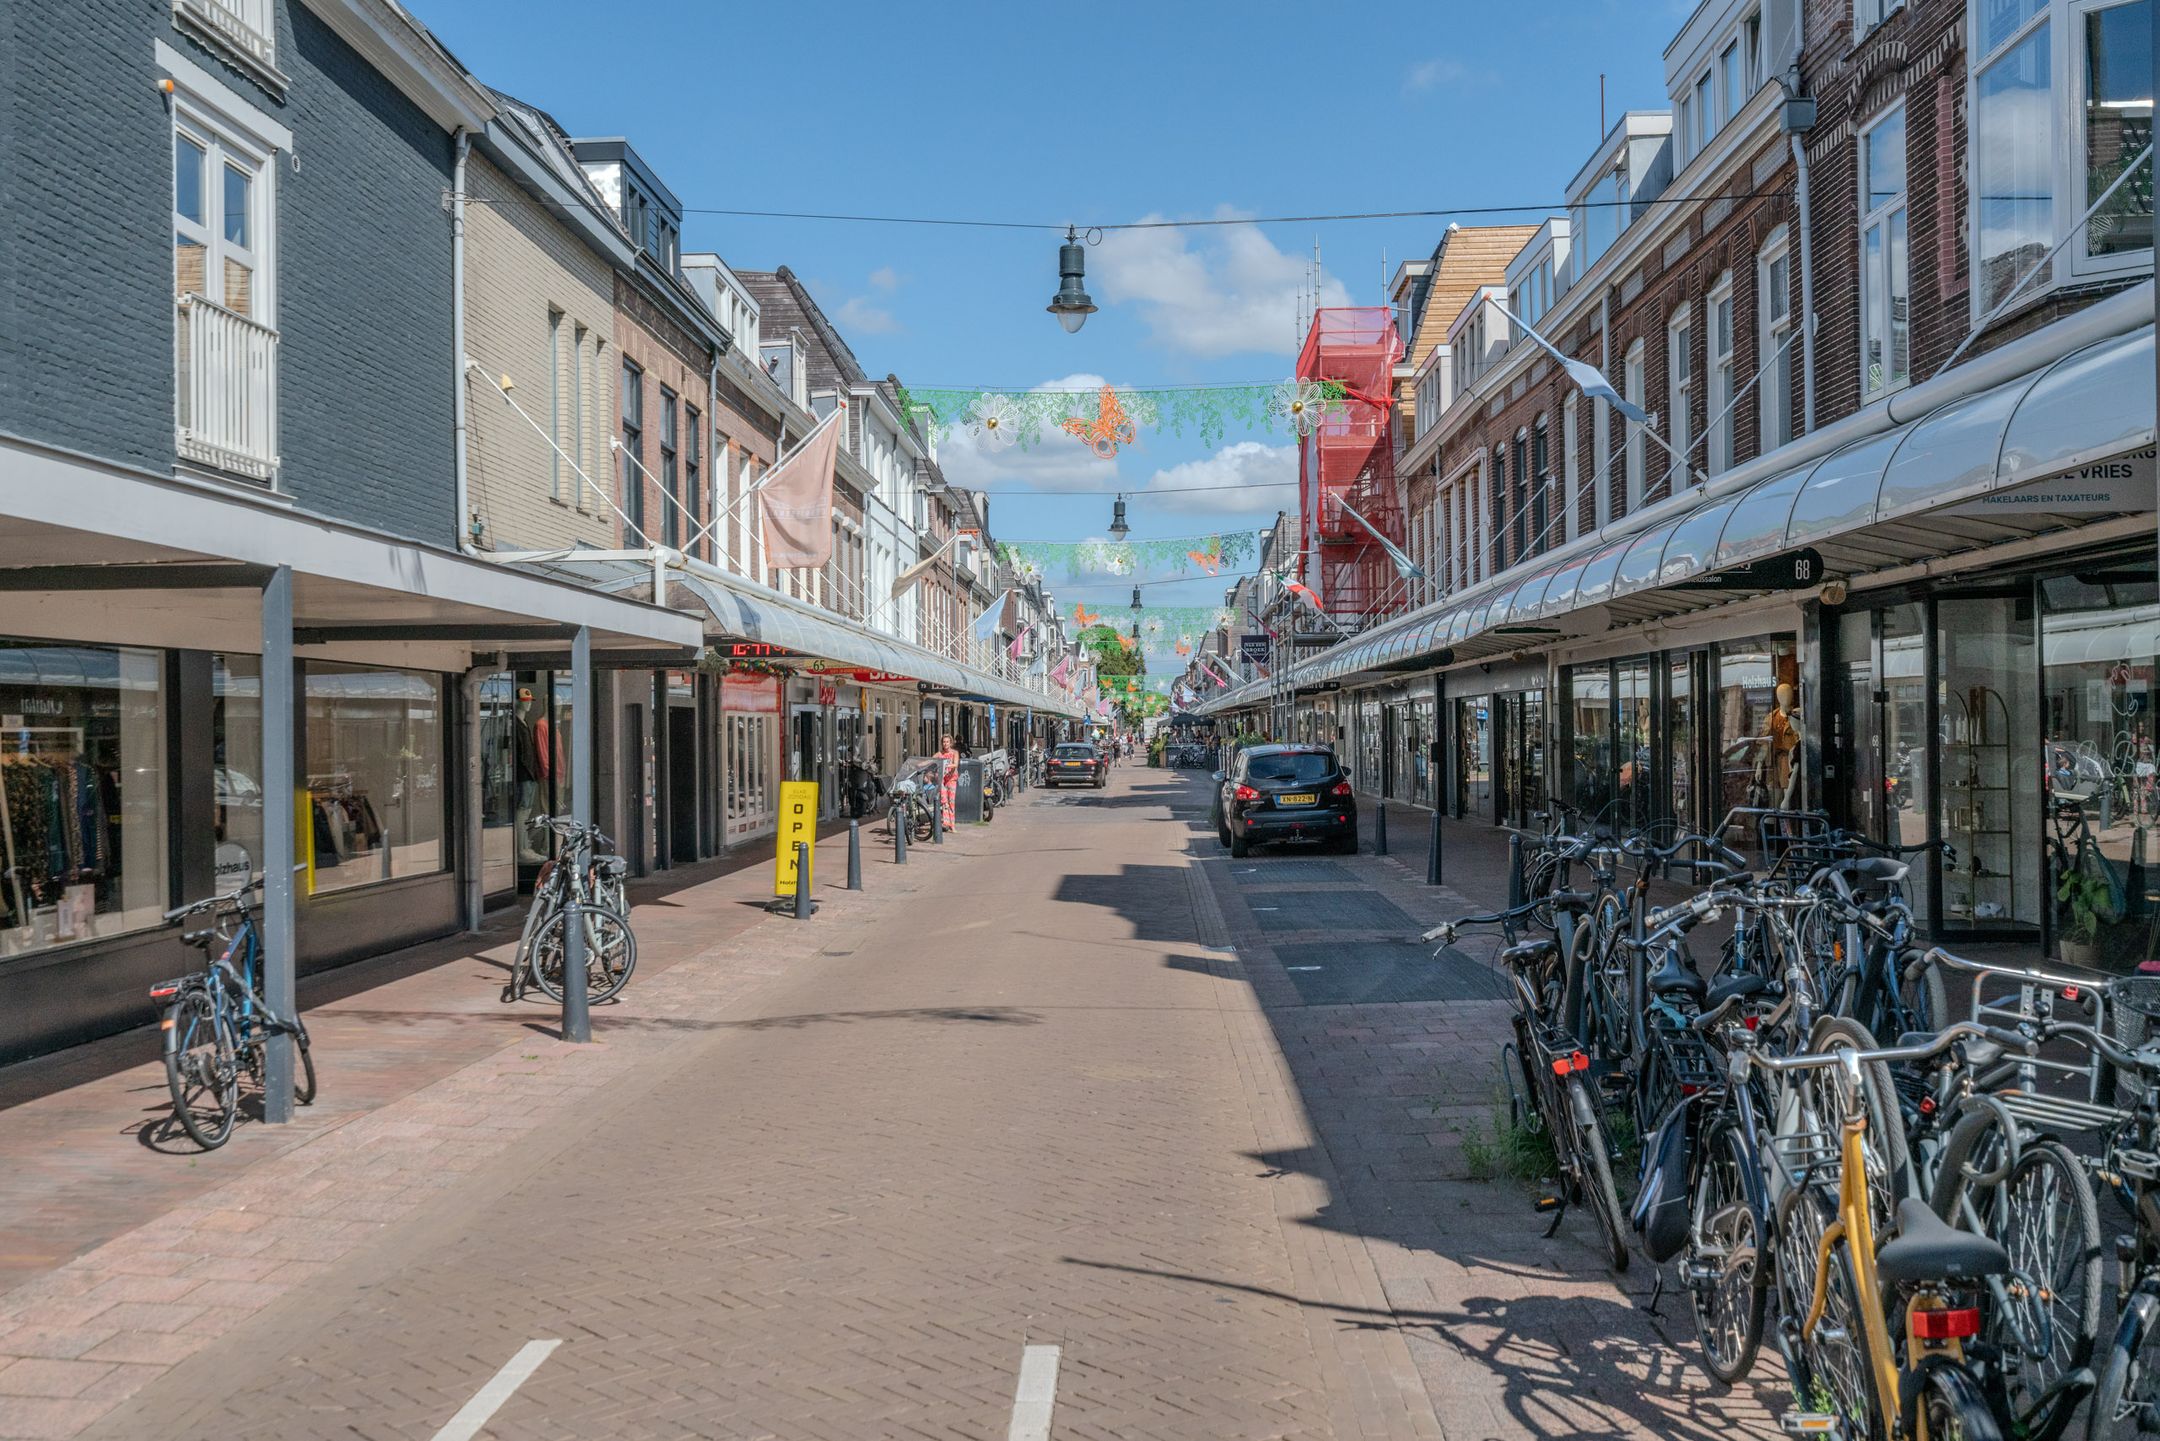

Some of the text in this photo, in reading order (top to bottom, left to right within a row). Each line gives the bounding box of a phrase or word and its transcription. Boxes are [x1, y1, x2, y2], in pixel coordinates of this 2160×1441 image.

[2080, 464, 2133, 479] VRIES
[1982, 493, 2111, 504] MAKELAARS EN TAXATEURS
[1795, 559, 1810, 580] 68
[813, 660, 825, 672] 65
[1742, 674, 1777, 689] Holzhaus
